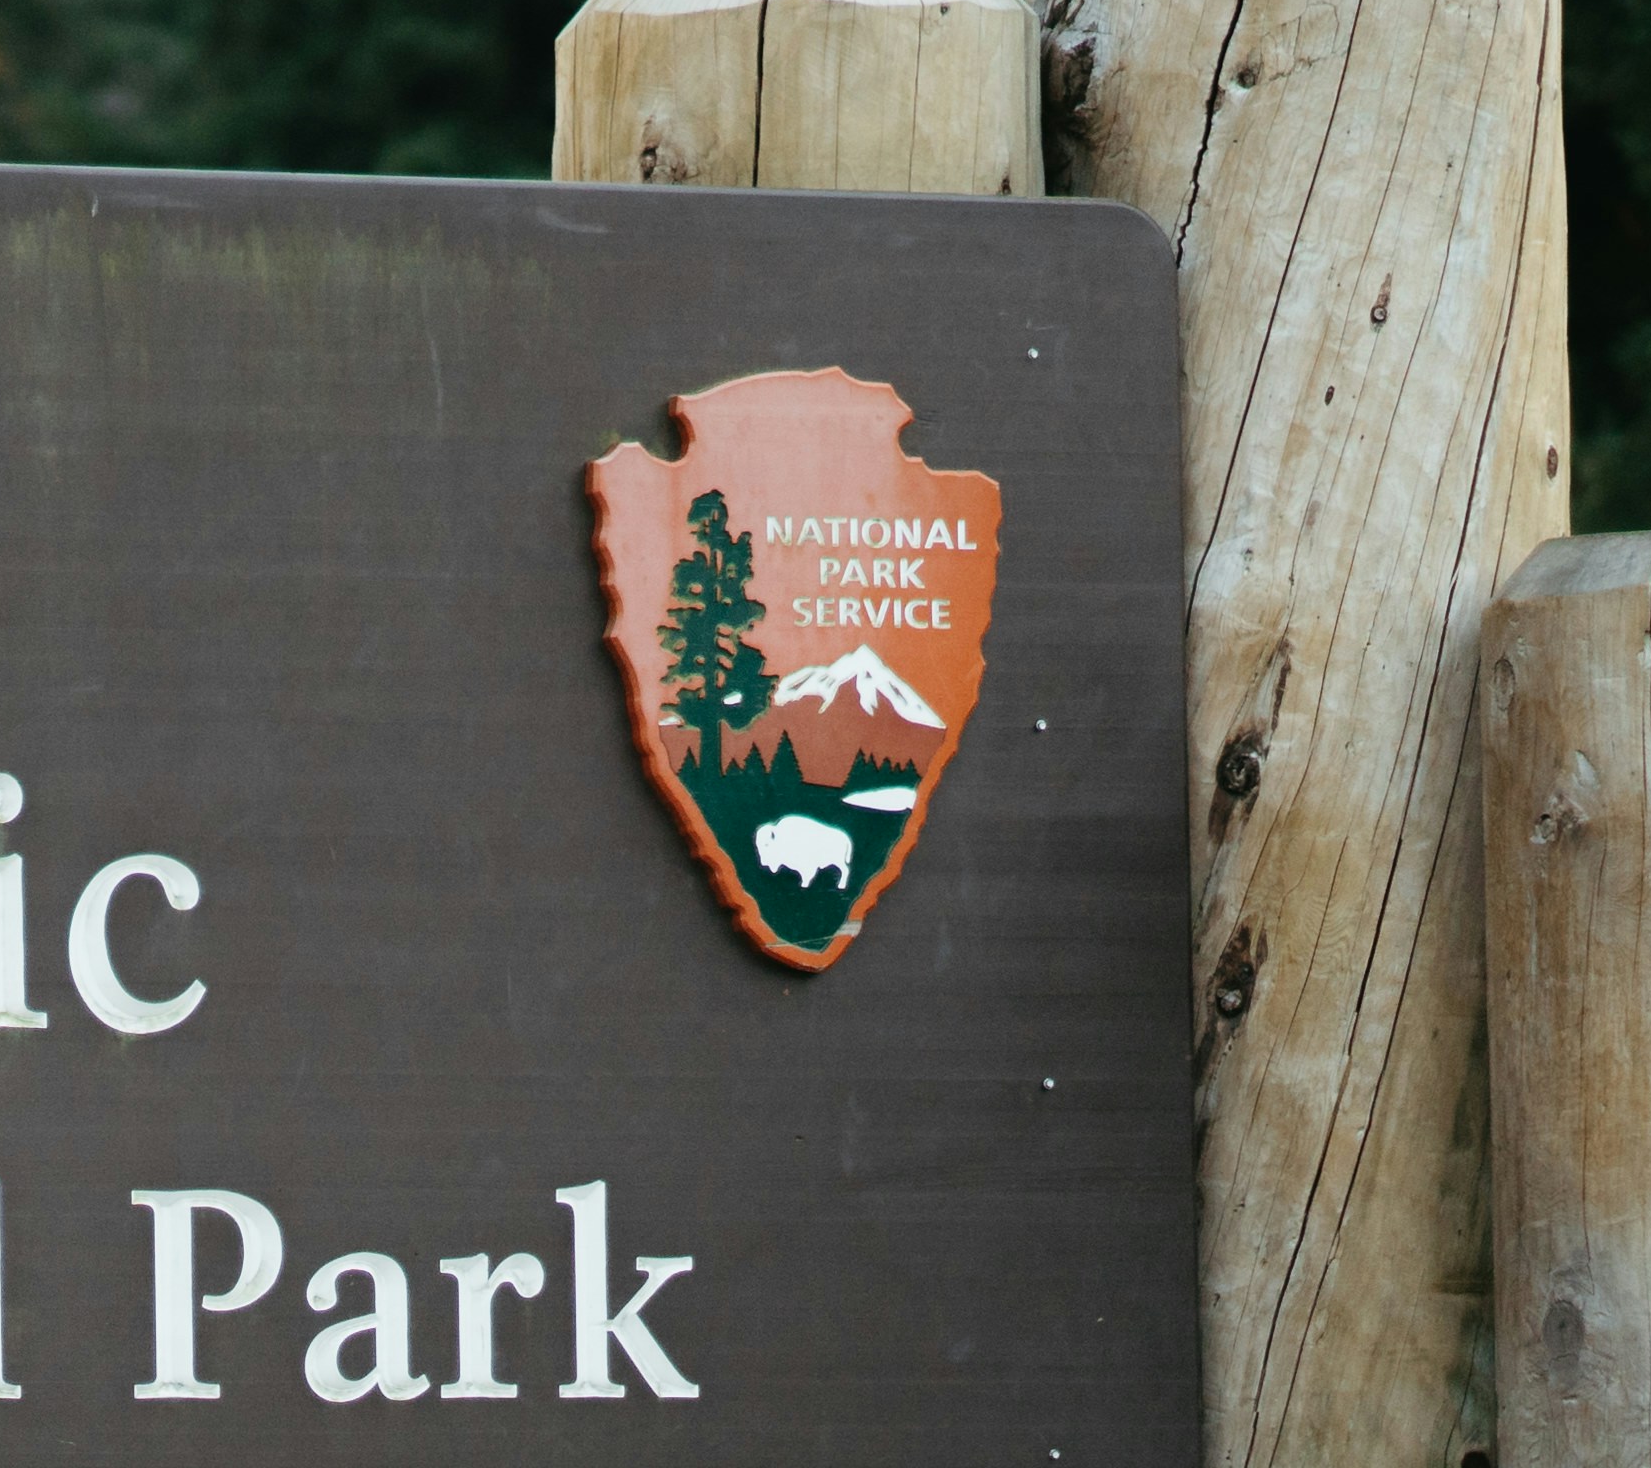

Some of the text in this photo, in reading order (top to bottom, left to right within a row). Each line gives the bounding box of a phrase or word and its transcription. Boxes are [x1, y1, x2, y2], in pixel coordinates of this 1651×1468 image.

[765, 515, 978, 551] NATIONAL
[818, 556, 925, 589] PARK
[791, 596, 952, 630] SERVICE
[129, 1178, 702, 1404] Park
